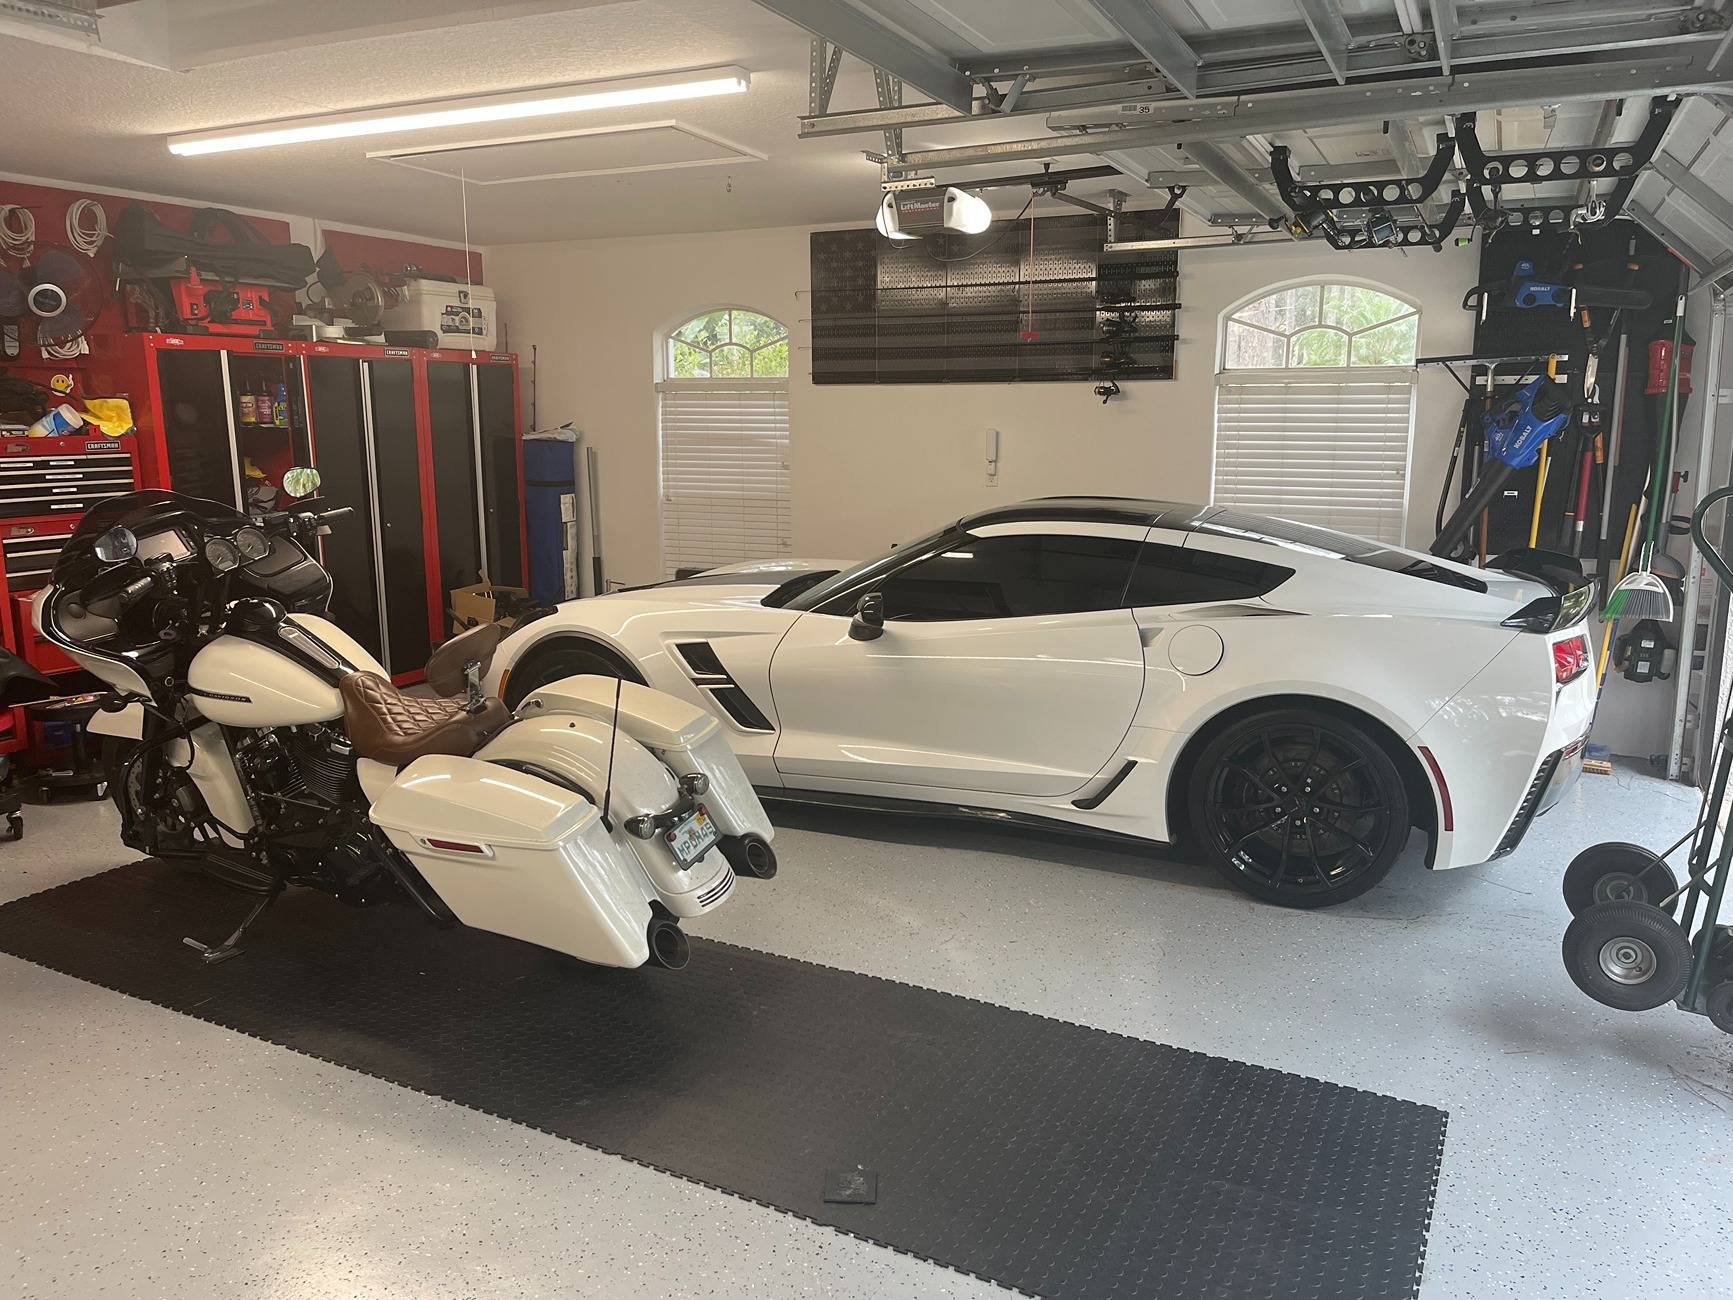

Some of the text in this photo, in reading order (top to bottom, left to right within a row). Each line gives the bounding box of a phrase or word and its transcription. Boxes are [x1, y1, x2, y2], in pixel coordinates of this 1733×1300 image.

[1139, 106, 1150, 114] 35
[901, 202, 940, 210] LiftMaster
[1514, 425, 1532, 449] KOBALT
